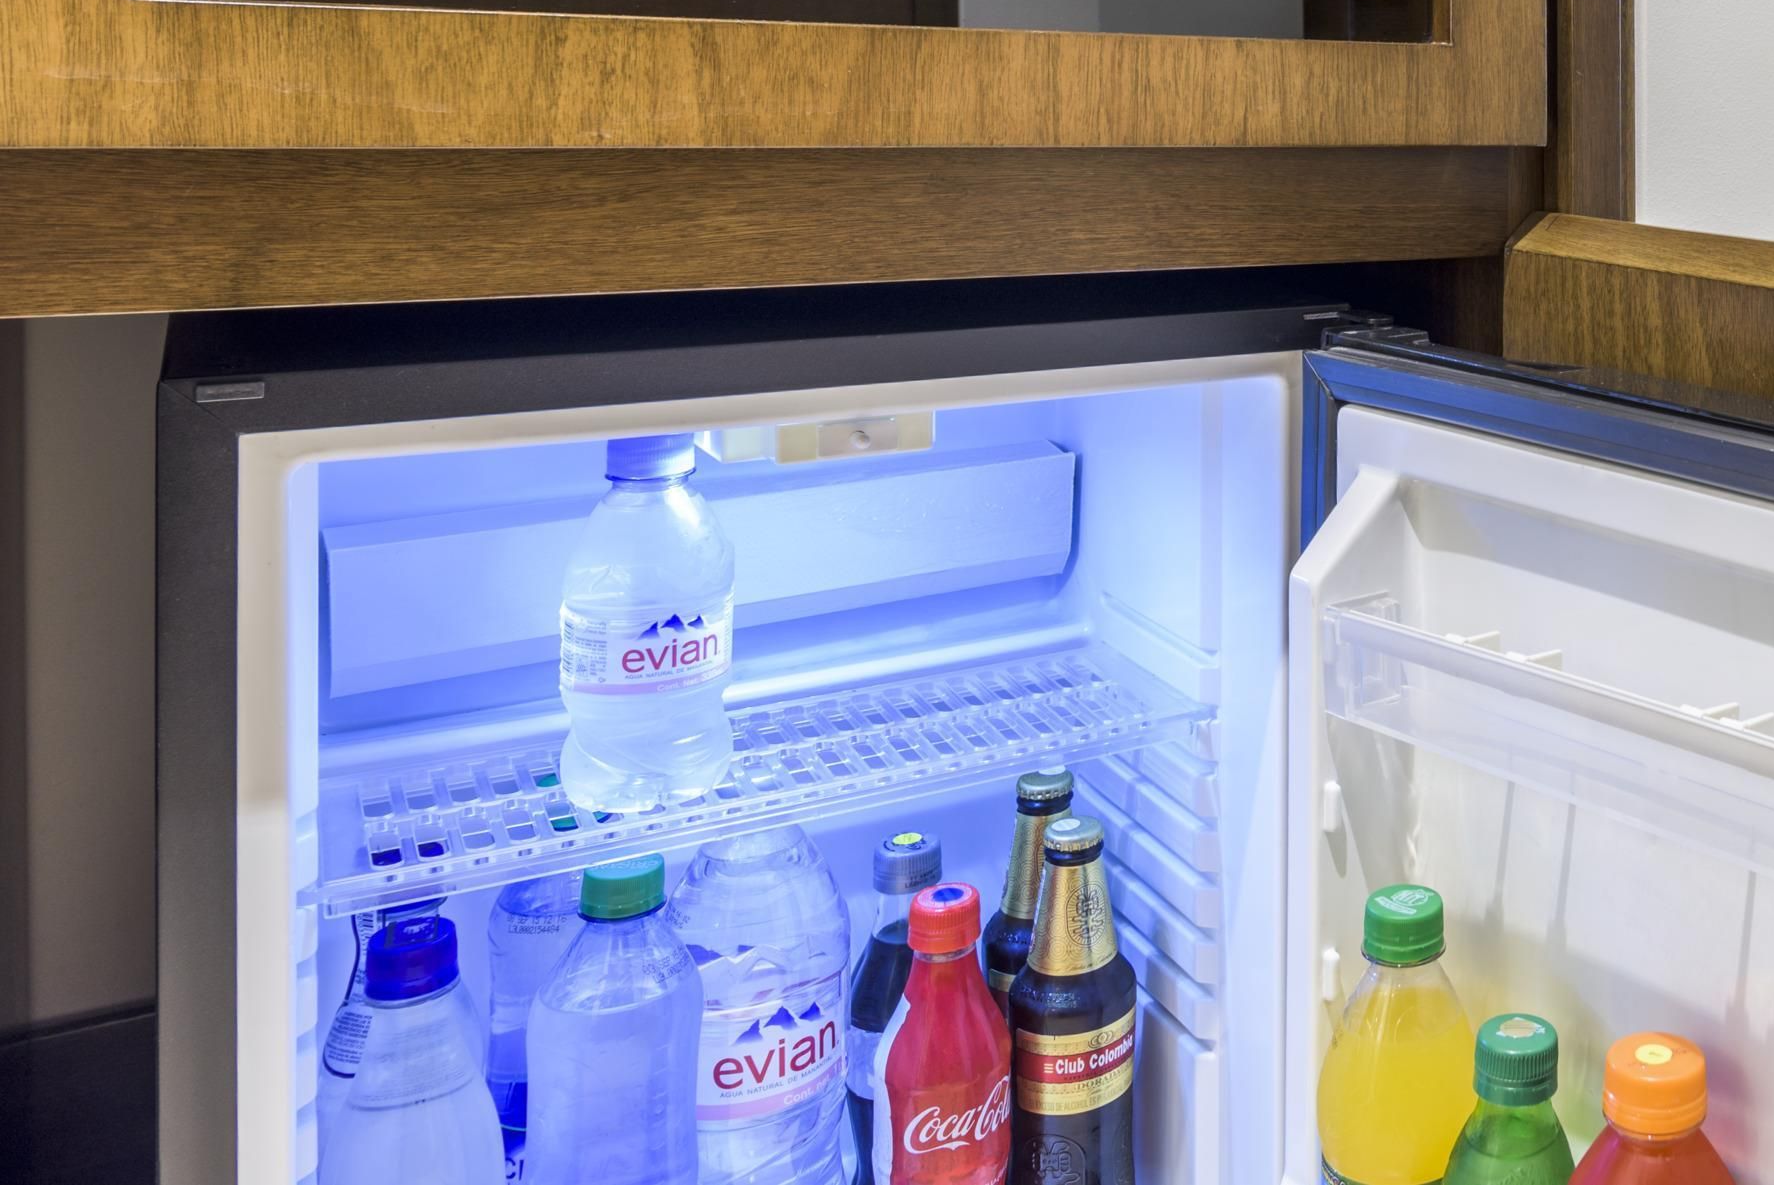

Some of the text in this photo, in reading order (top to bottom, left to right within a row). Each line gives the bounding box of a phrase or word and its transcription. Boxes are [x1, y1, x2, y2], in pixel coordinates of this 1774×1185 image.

[621, 633, 718, 673] evian
[712, 1020, 836, 1090] evian
[1055, 1057, 1085, 1074] Club
[720, 1091, 744, 1099] AGUA
[747, 1081, 784, 1096] NATURAL
[787, 1075, 798, 1085] DE
